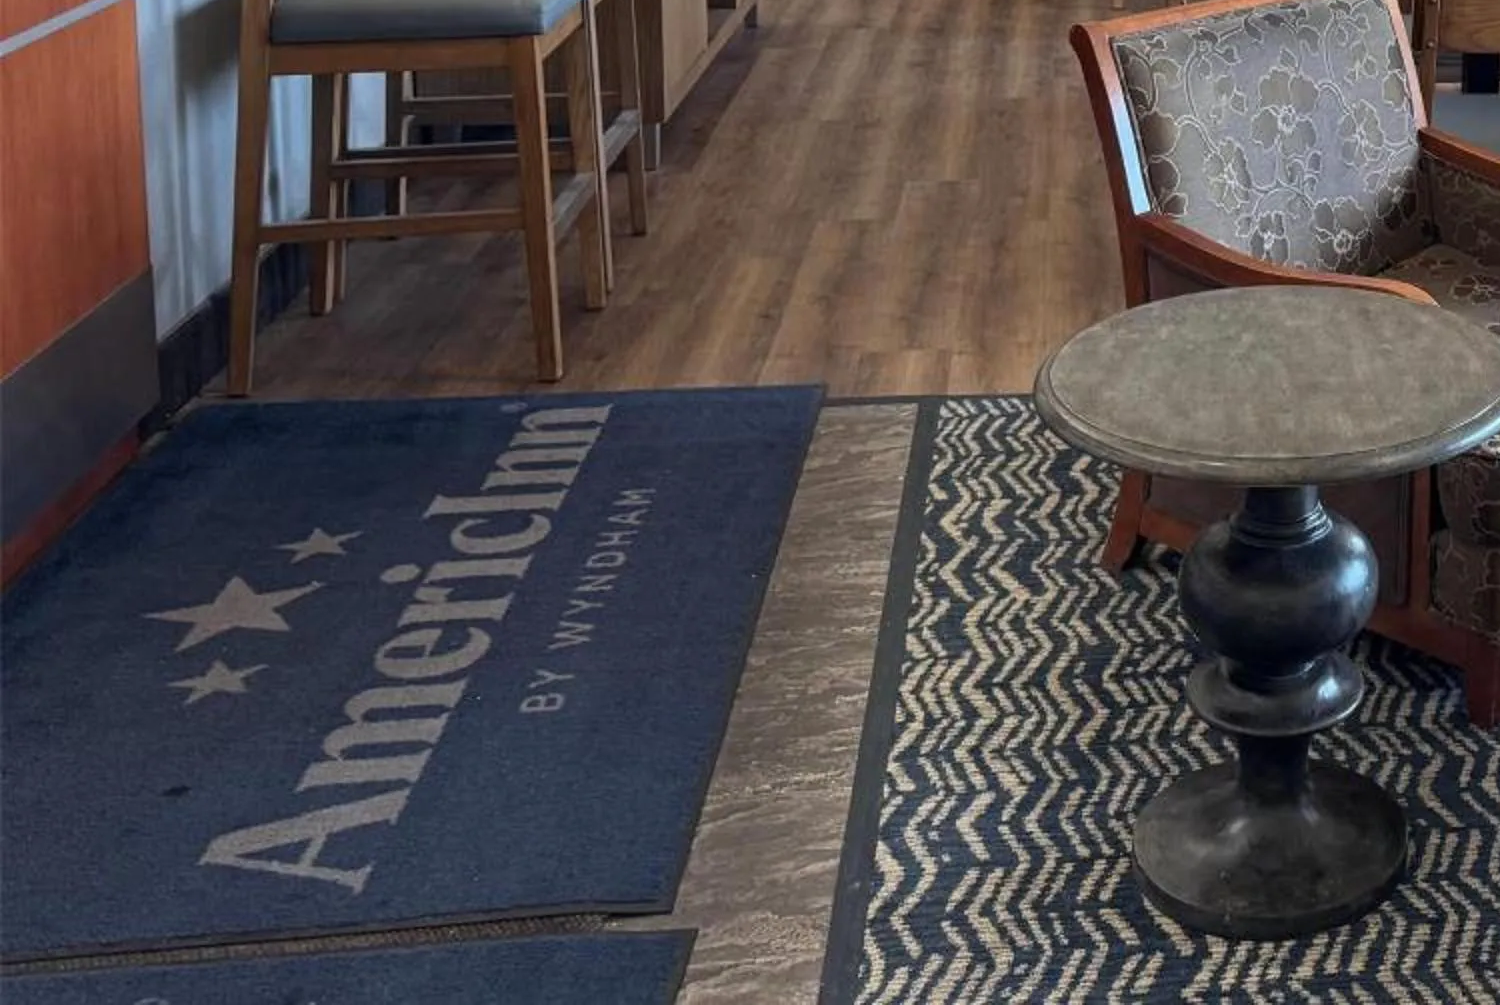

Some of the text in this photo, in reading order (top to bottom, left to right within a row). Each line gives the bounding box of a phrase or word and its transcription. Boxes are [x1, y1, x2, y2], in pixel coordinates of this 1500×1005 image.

[198, 404, 613, 895] AmericInn
[519, 488, 657, 714] BY WYNDHAM
